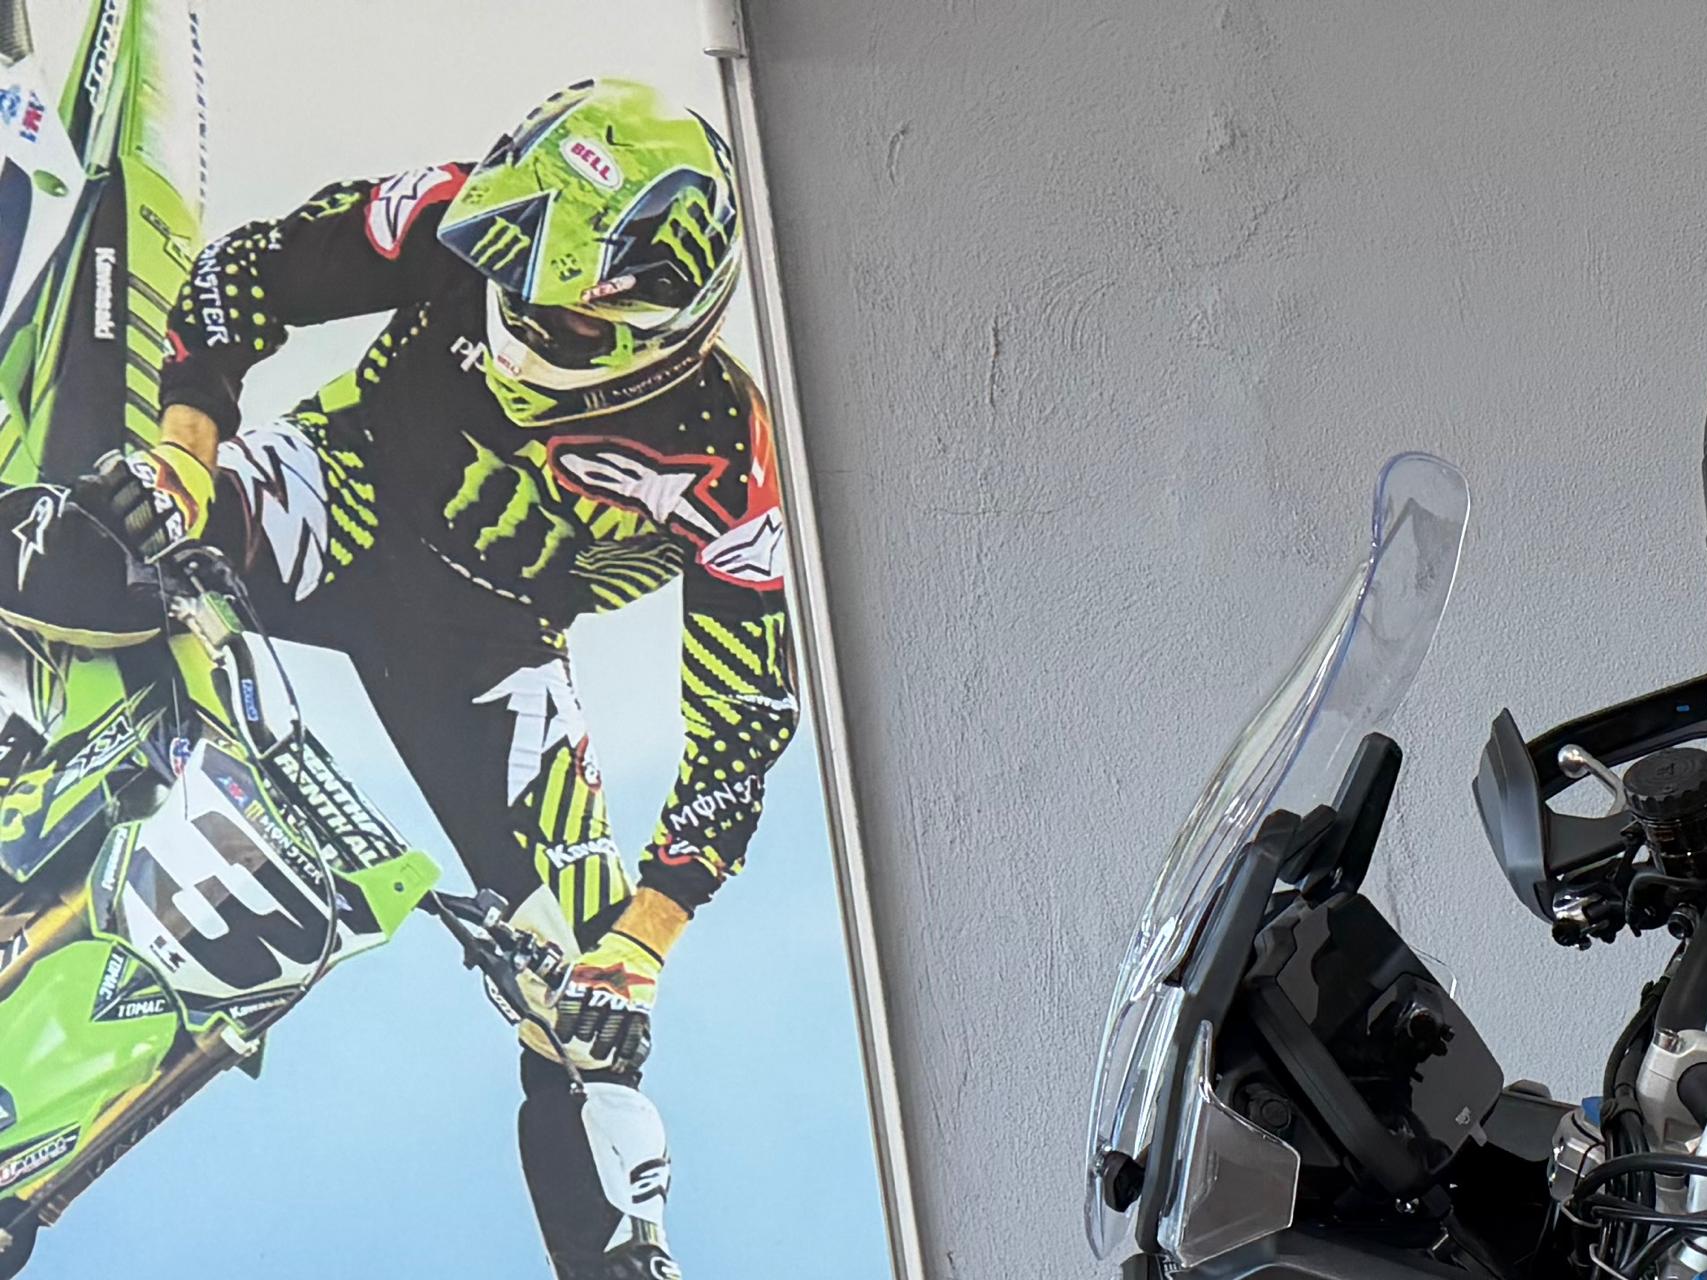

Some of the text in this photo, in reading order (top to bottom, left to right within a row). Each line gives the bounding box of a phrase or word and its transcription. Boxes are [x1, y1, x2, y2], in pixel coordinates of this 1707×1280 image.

[571, 142, 612, 181] BELL
[94, 246, 117, 341] Kawasaki
[272, 751, 382, 869] RENTHAL
[117, 999, 166, 1019] TOMAC
